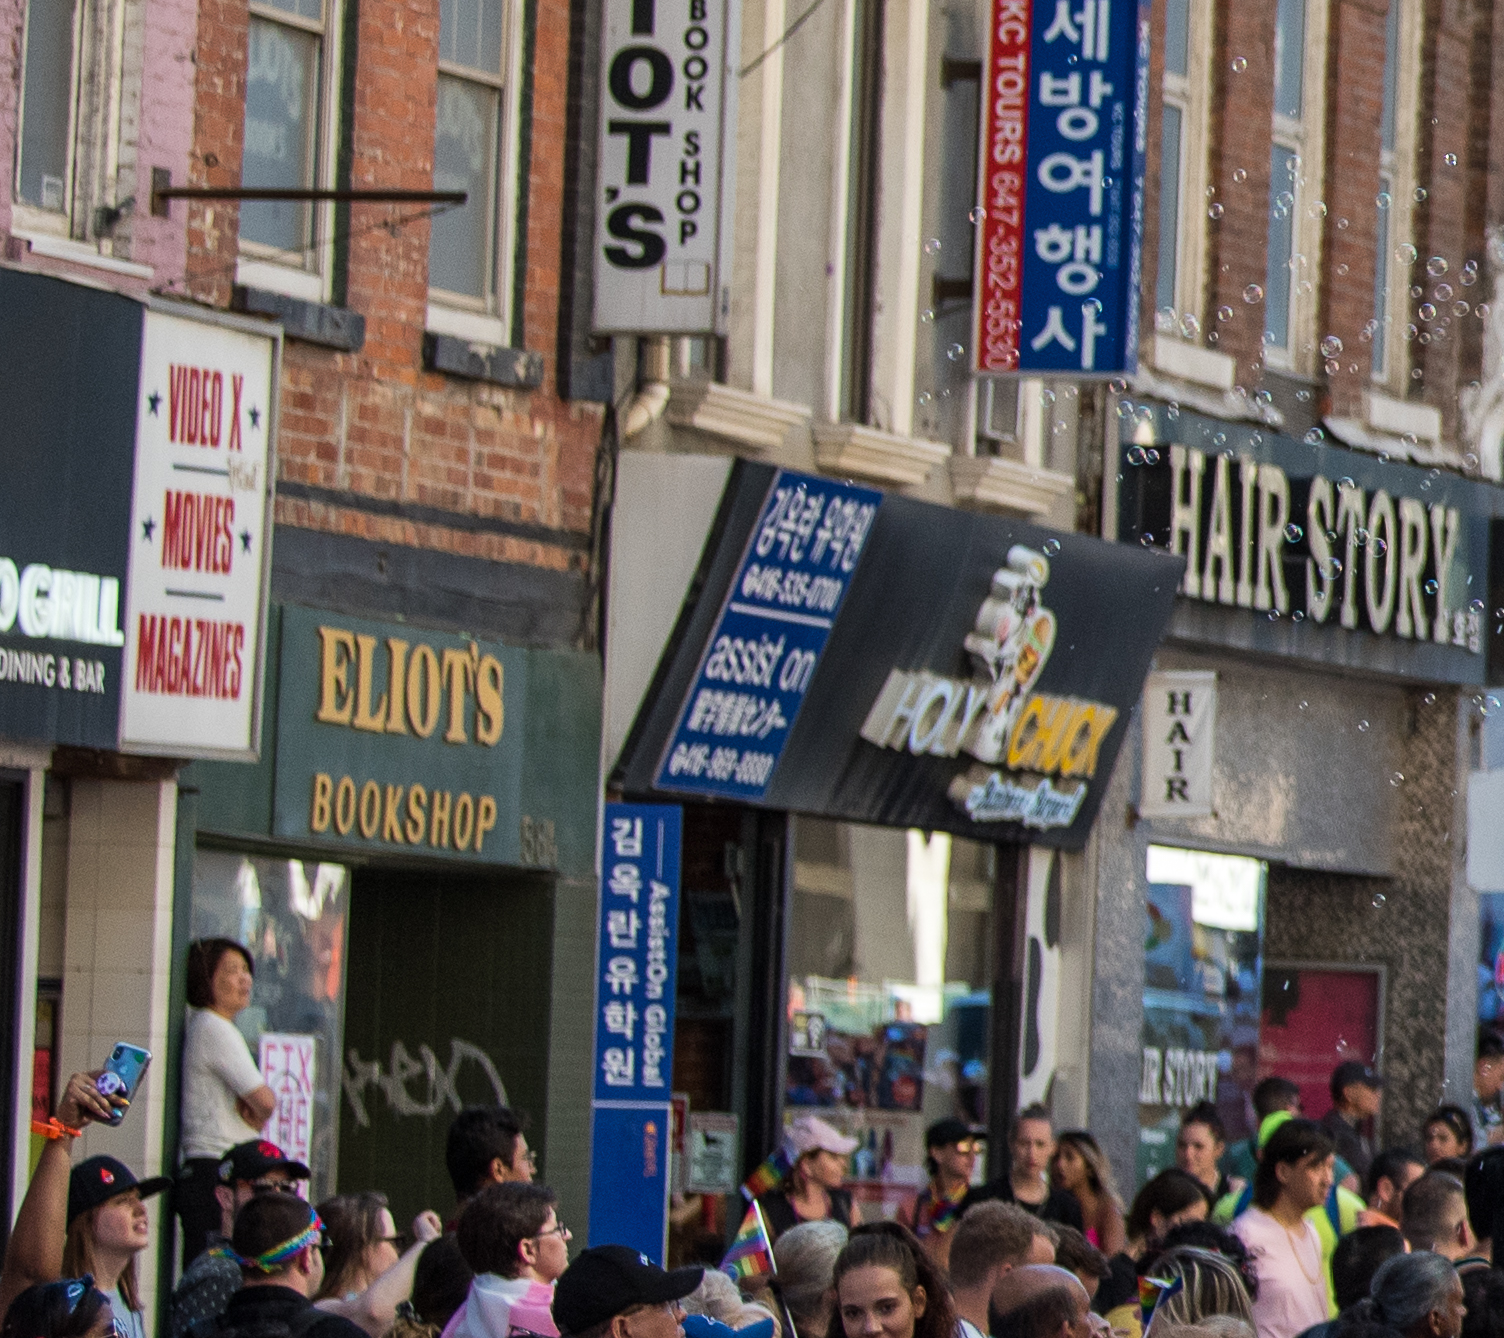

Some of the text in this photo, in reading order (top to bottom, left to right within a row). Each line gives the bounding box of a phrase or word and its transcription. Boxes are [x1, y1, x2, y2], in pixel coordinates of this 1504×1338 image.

[994, 51, 1027, 165] TOURS
[168, 363, 245, 451] VIDEO X
[161, 489, 236, 576] MOVIES
[1169, 445, 1461, 644] HAIR STORY
[74, 659, 106, 694] BAR
[135, 612, 246, 700] MAGAZINES
[316, 624, 505, 748] ELIOT'S
[704, 634, 817, 694] assist on
[881, 680, 989, 758] HOLY
[1166, 690, 1192, 803] HAIR
[312, 773, 497, 853] BOOKSHOP
[642, 1004, 668, 1089] Global
